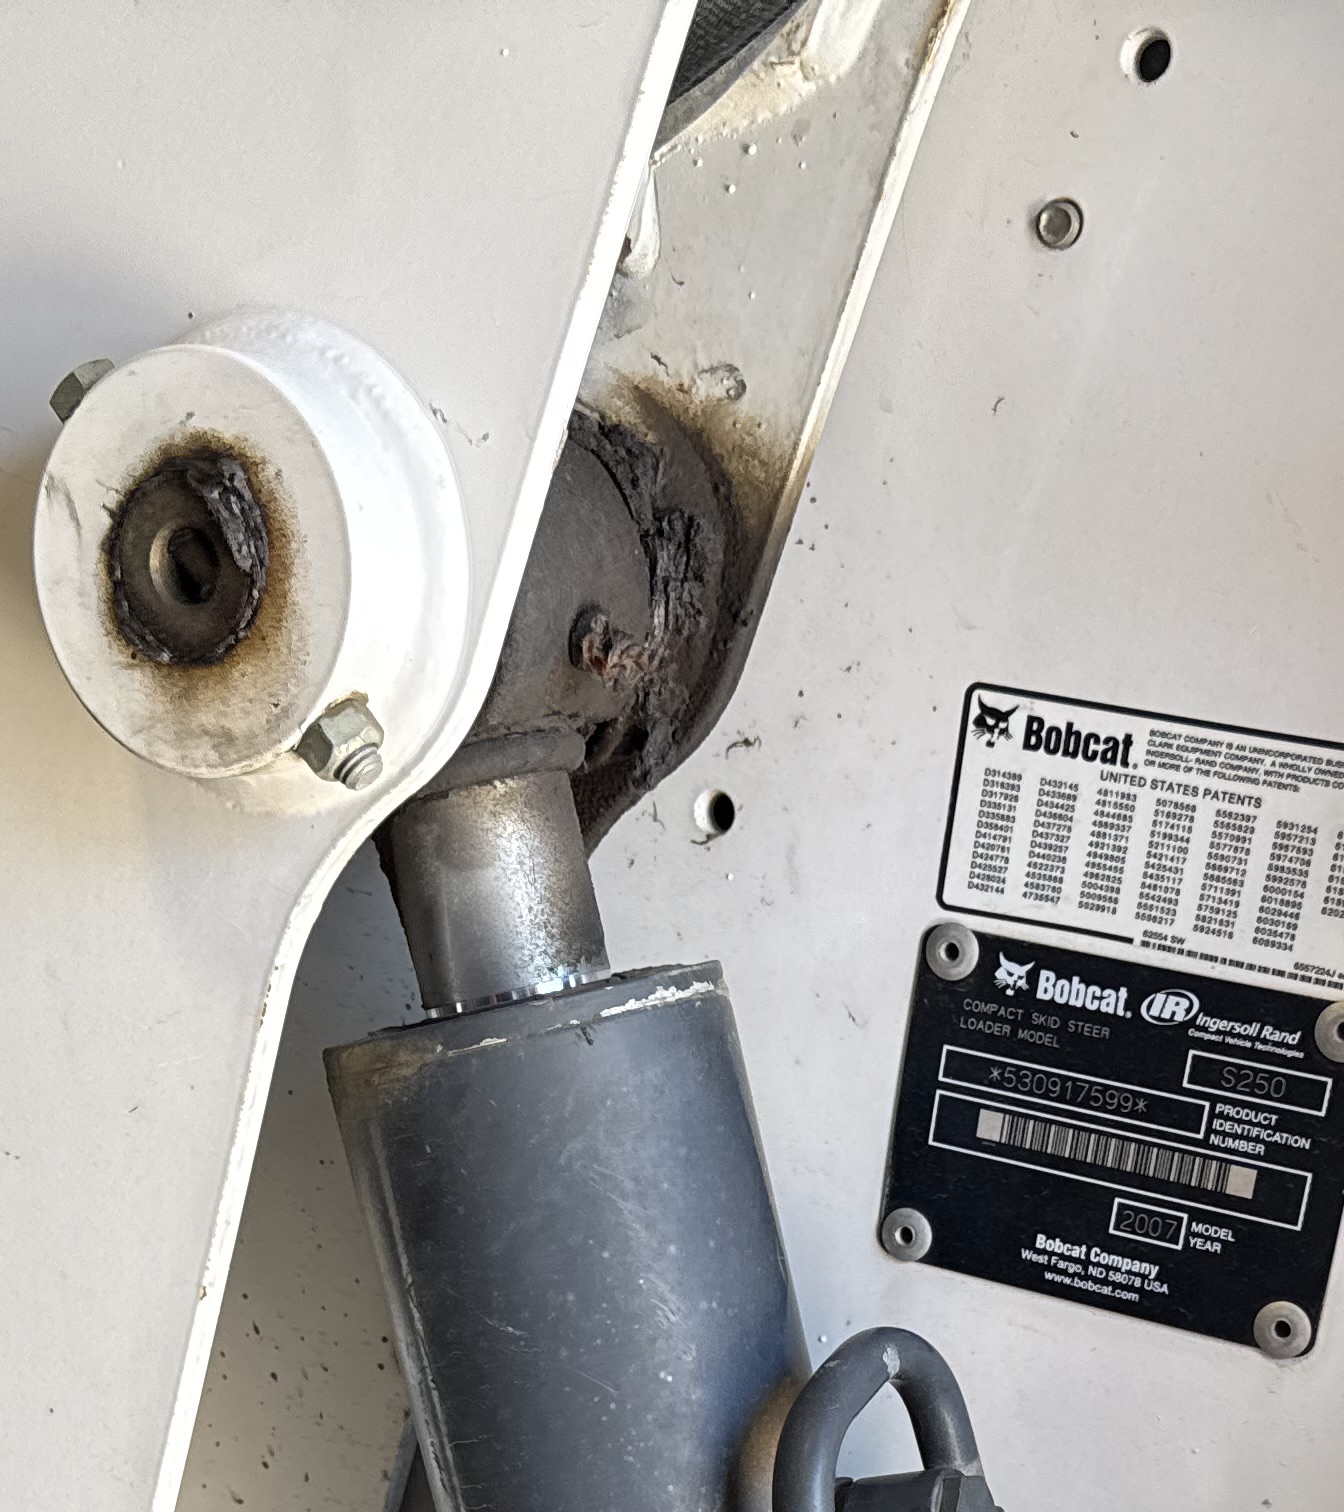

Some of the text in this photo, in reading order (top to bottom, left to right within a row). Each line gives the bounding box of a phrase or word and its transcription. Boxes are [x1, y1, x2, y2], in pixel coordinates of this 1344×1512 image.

[1148, 729, 1182, 740] BOBCAT
[1183, 734, 1224, 748] COMPANY
[1234, 743, 1246, 752] AN
[1143, 758, 1156, 767] OR
[1157, 761, 1181, 772] MORE
[1182, 765, 1194, 773] OF
[1195, 767, 1211, 777] THE
[1212, 770, 1260, 785] FOLLOWING
[1175, 743, 1222, 758] EQUIPMENT
[1278, 761, 1312, 773] WHOLLY
[1313, 767, 1344, 779] OWNED
[1194, 757, 1217, 767] RAND
[1263, 769, 1284, 779] WITH
[1285, 772, 1330, 787] PRODUCTS
[1099, 769, 1262, 808] UNITED STATES PATENTS
[959, 1016, 1059, 1047] LOADER MODEL
[963, 998, 1110, 1038] COMPACT SKID STEER
[1195, 1012, 1301, 1044] Ingersoll Rand
[1187, 1027, 1223, 1041] Compact
[1220, 1066, 1286, 1097] S250
[1214, 1103, 1278, 1125] PRODUCT
[1209, 1133, 1264, 1155] NUMBER
[1212, 1118, 1310, 1149] IDENTIFICATION
[1119, 1210, 1177, 1238] 2007
[1190, 1221, 1234, 1241] MODEL
[1035, 1233, 1159, 1278] Bobcat Company
[1188, 1236, 1221, 1253] YEAR
[1021, 1248, 1168, 1294] West Fargo, ND 58078 USA
[1044, 1271, 1139, 1301] www.bobcat.com
